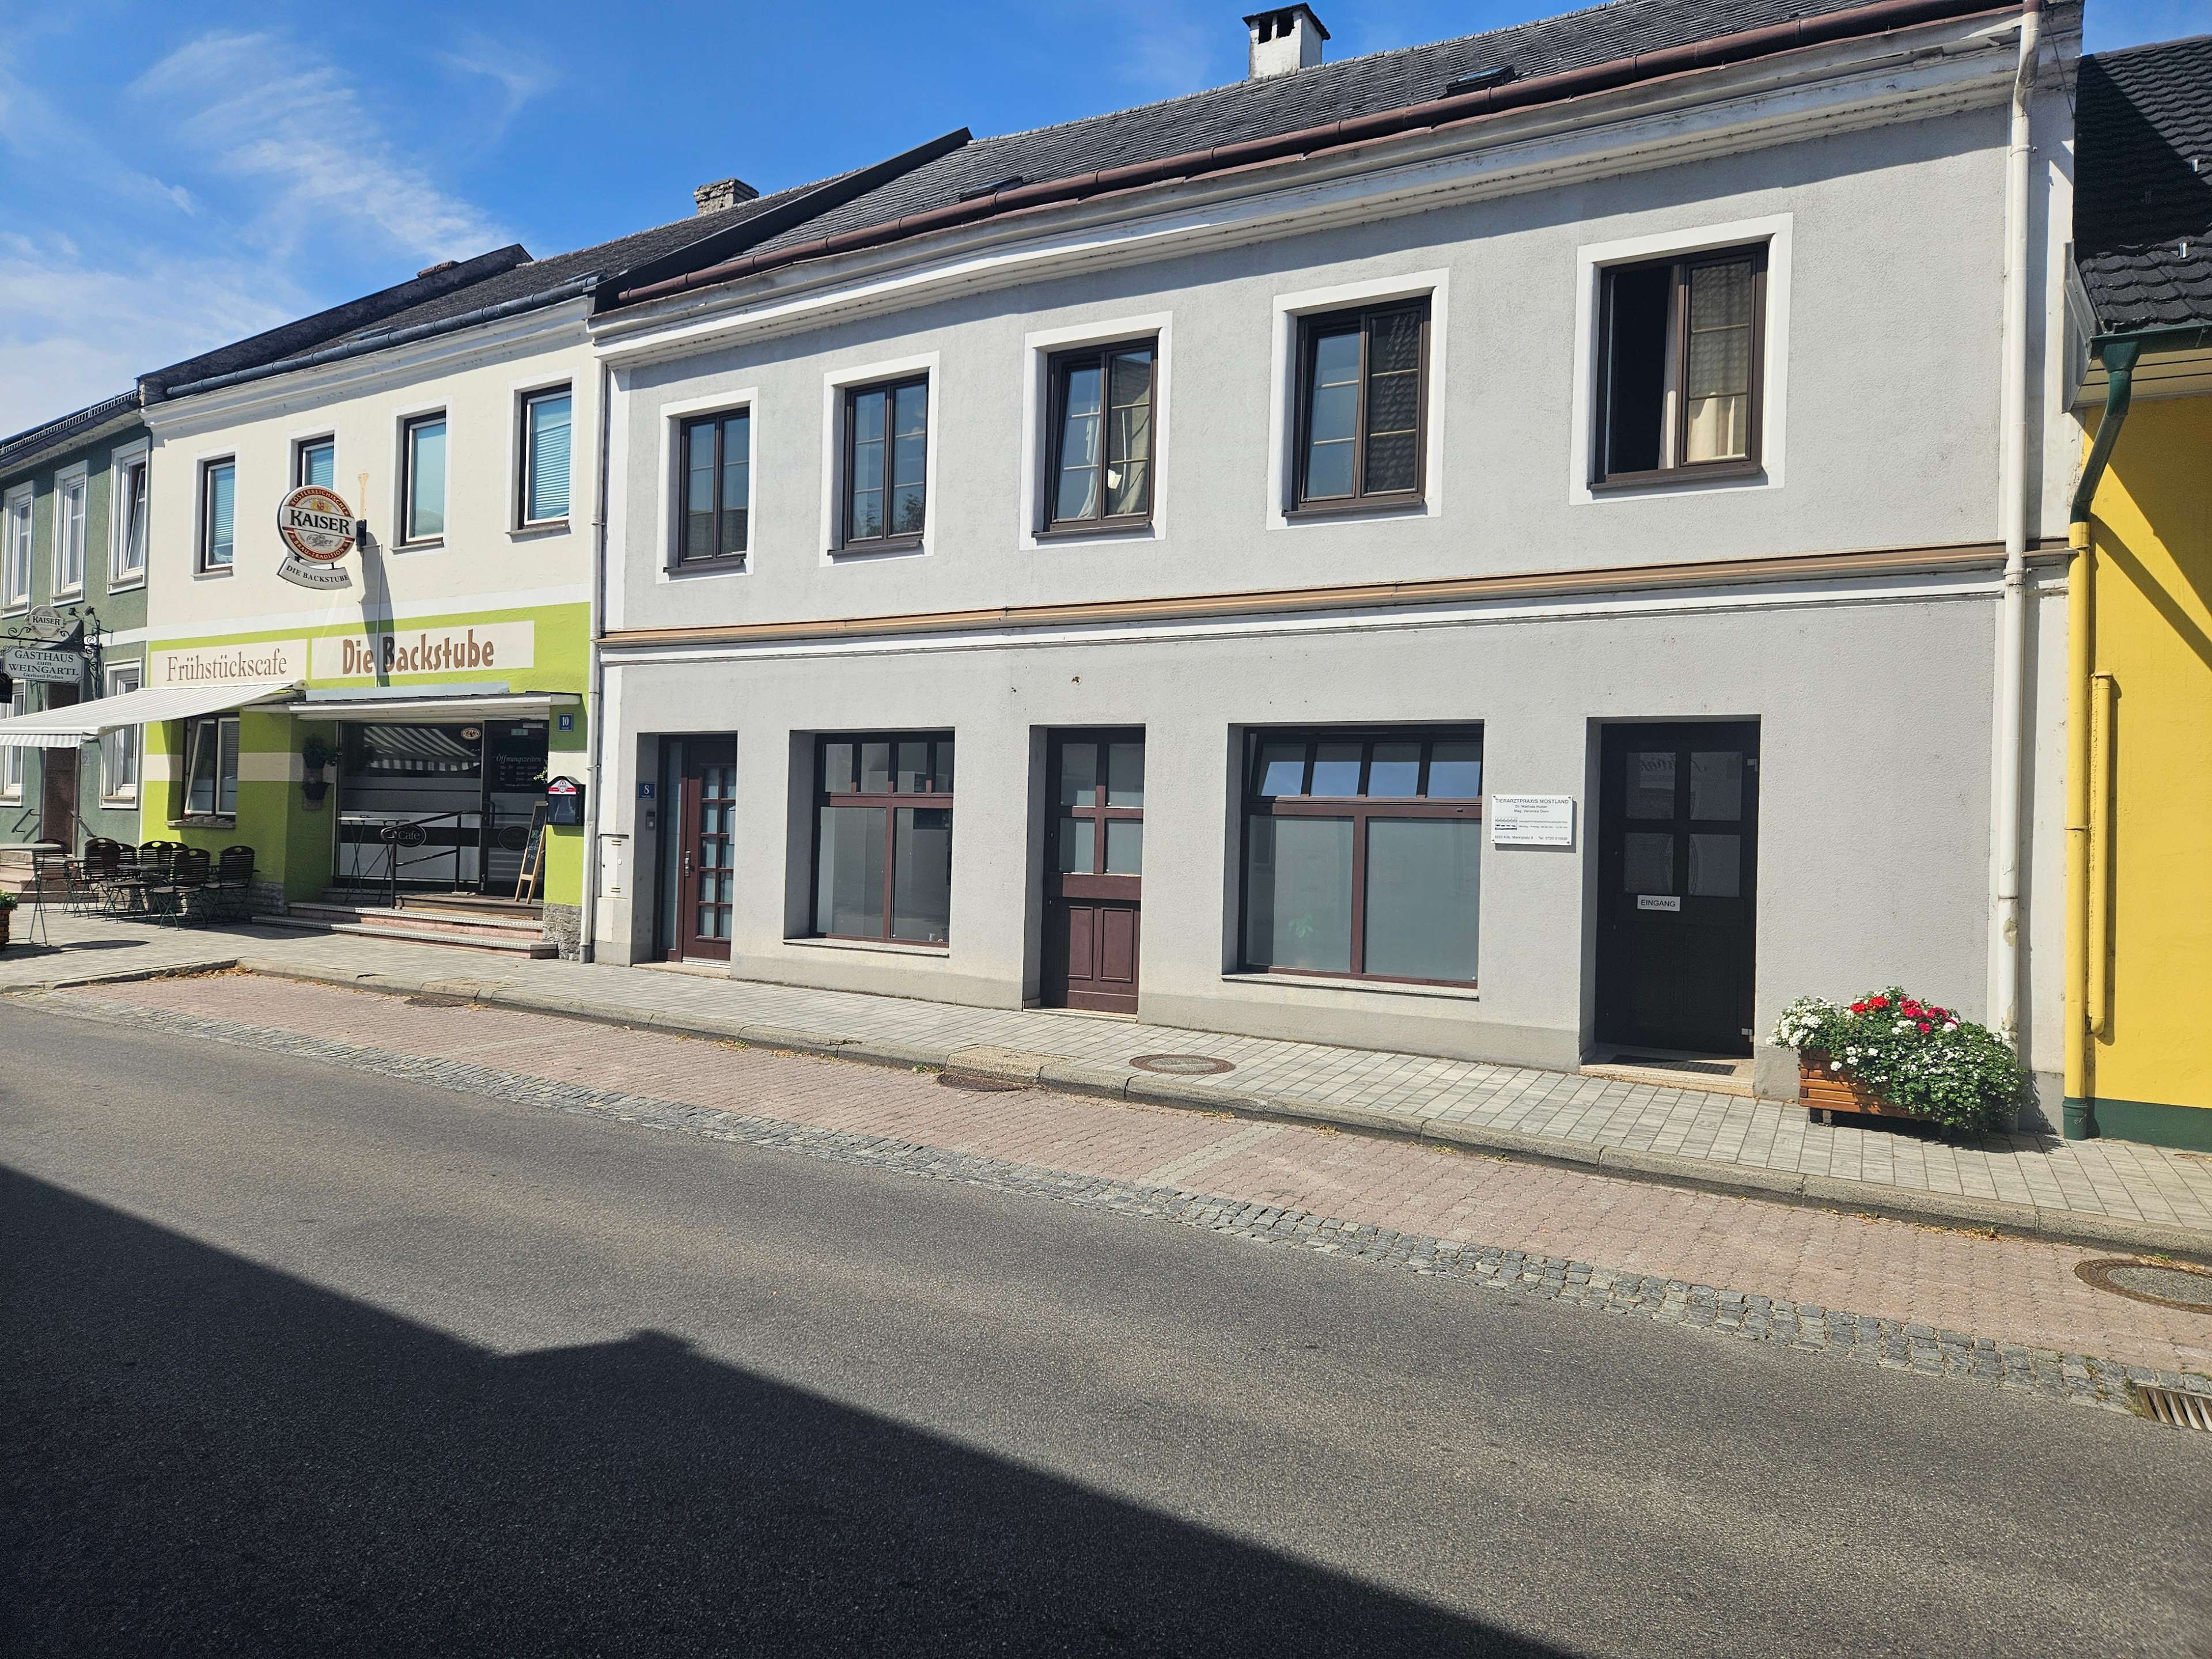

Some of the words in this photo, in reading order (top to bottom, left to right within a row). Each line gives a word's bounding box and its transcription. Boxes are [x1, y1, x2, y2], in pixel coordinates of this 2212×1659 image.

[290, 509, 351, 536] KAISER
[294, 540, 346, 559] BRAU-TRADITION
[286, 565, 301, 576] DIE
[302, 572, 349, 582] BACKSTUBE
[32, 616, 60, 626] KAISER
[14, 650, 74, 662] GASTHAUS
[342, 639, 374, 675] Die
[382, 628, 494, 673] Backstube
[9, 663, 79, 676] WEINGARTL
[166, 648, 287, 681] Frühstückscafe
[562, 717, 569, 726] 10
[643, 785, 650, 794] 8
[398, 830, 420, 840] Cafe
[1641, 899, 1676, 907] EINGANG
